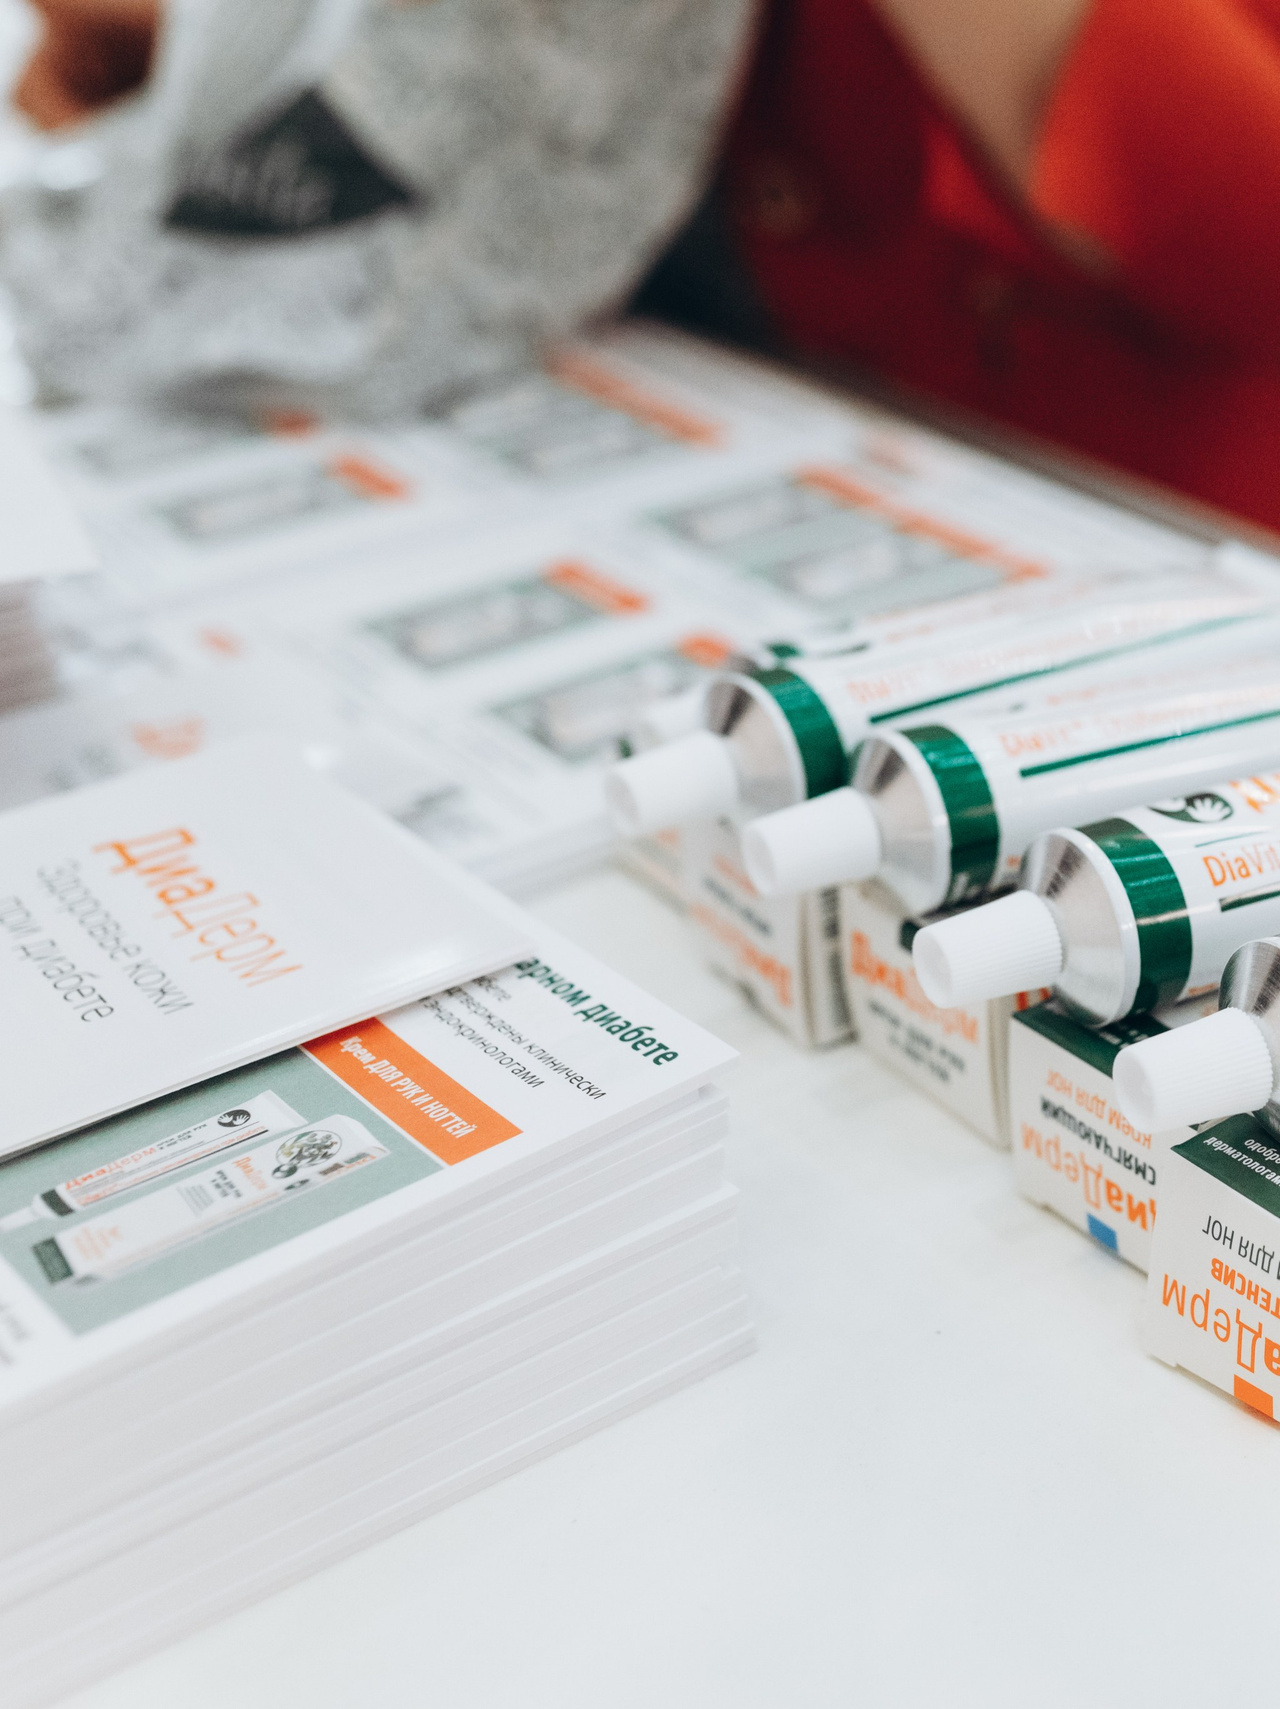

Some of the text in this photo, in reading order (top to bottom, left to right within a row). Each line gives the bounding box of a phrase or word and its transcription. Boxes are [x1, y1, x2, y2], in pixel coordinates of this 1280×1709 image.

[37, 856, 196, 1016] Здоровье кожи
[91, 827, 304, 988] ДиаДерм
[16, 937, 115, 1022] диабете
[514, 956, 680, 1067] арном диабете
[340, 1036, 478, 1140] Крем ДЛЯ РУК И НОГТЕЙ
[523, 1041, 608, 1101] клинически
[1201, 1214, 1236, 1251] ног
[1237, 1235, 1275, 1275] для
